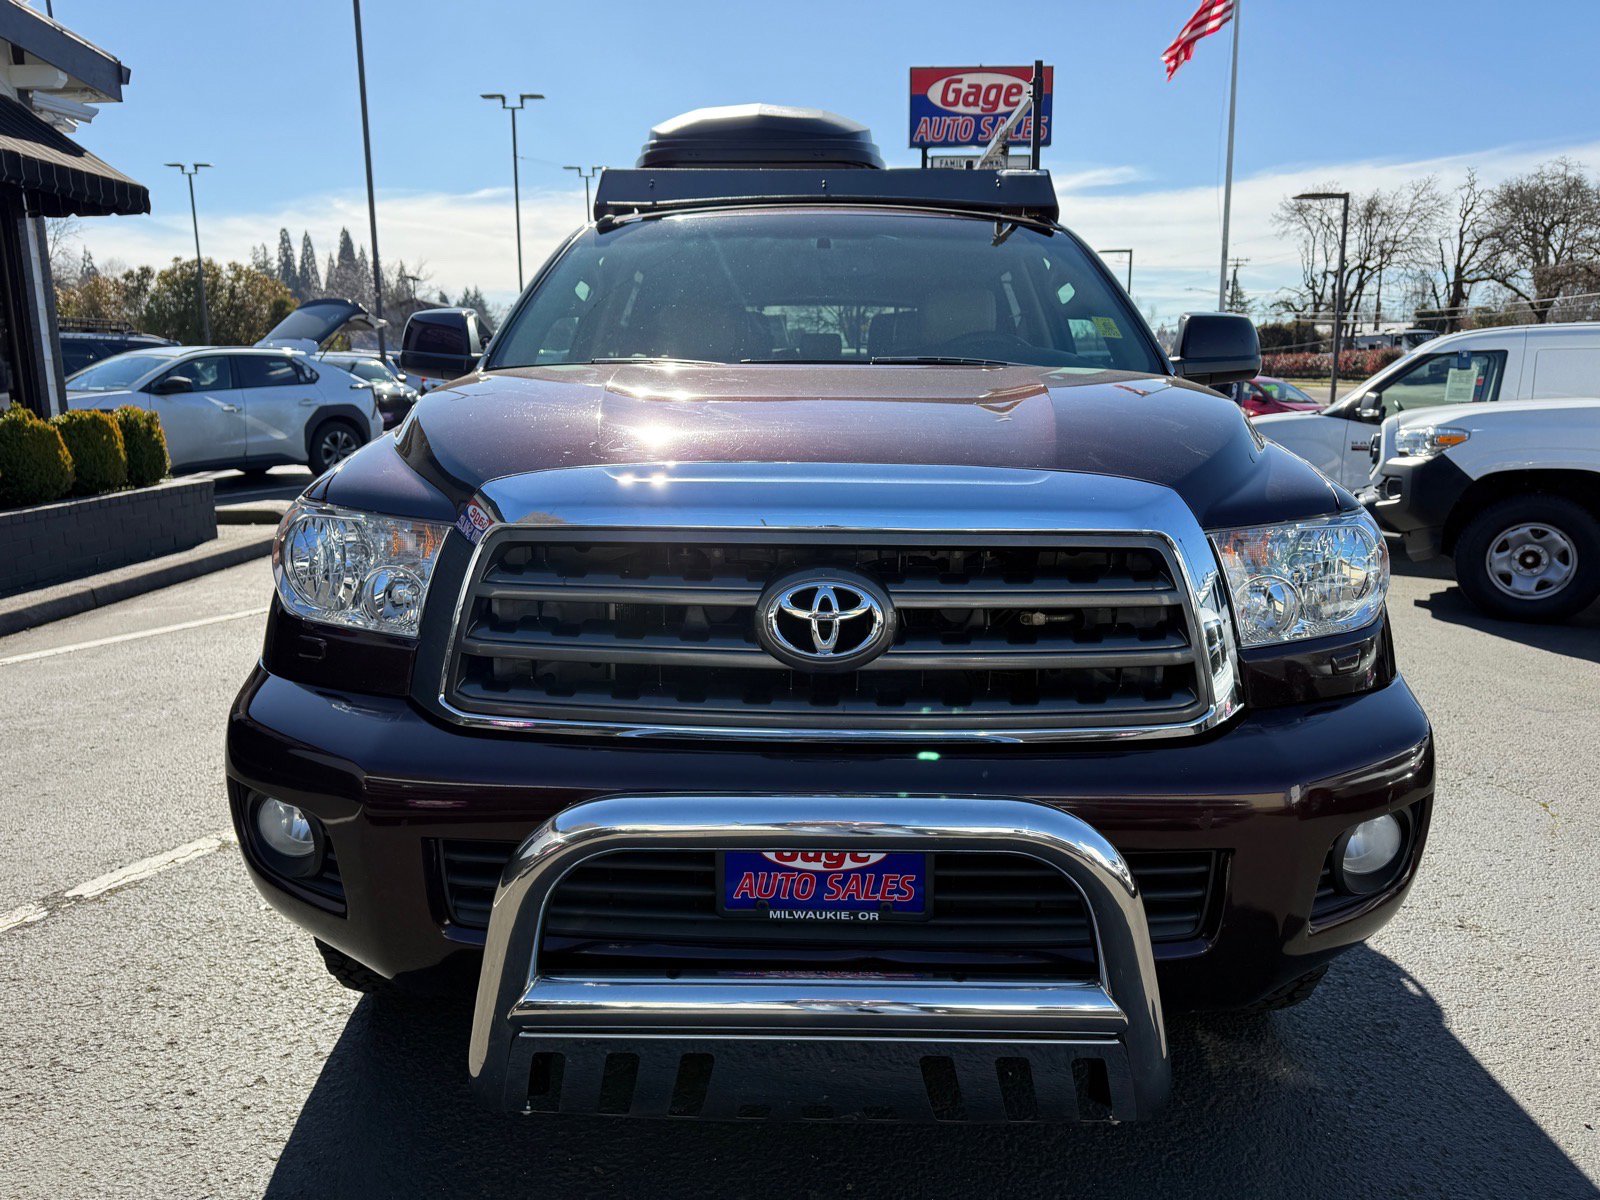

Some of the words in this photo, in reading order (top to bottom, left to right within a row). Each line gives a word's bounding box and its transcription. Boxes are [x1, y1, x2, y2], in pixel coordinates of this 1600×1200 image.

[940, 78, 1022, 112] Gage
[914, 116, 975, 142] AUTO
[733, 872, 817, 900] AUTO
[824, 873, 916, 902] SALES
[769, 910, 854, 920] MILWAUKIE,
[858, 911, 880, 921] OR
